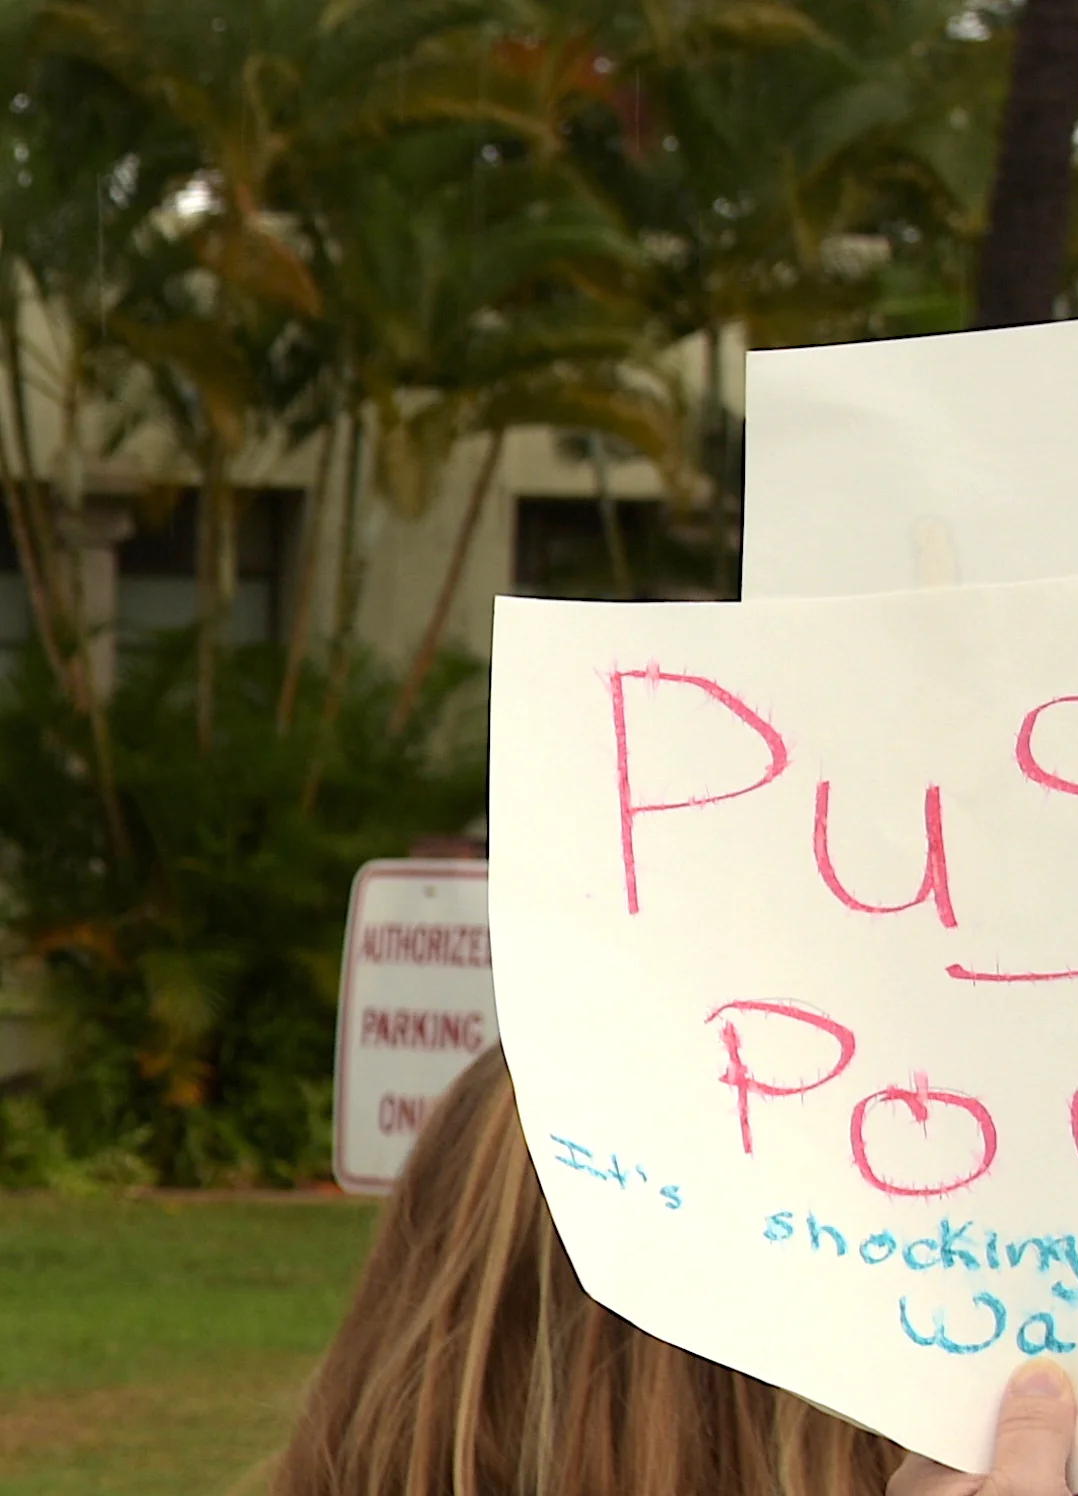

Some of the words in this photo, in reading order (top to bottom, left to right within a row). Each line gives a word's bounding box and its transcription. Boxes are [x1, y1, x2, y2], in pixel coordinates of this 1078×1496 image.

[361, 922, 491, 968] AUTHORIZE
[360, 1005, 485, 1049] PARKING
[549, 1133, 682, 1210] It's
